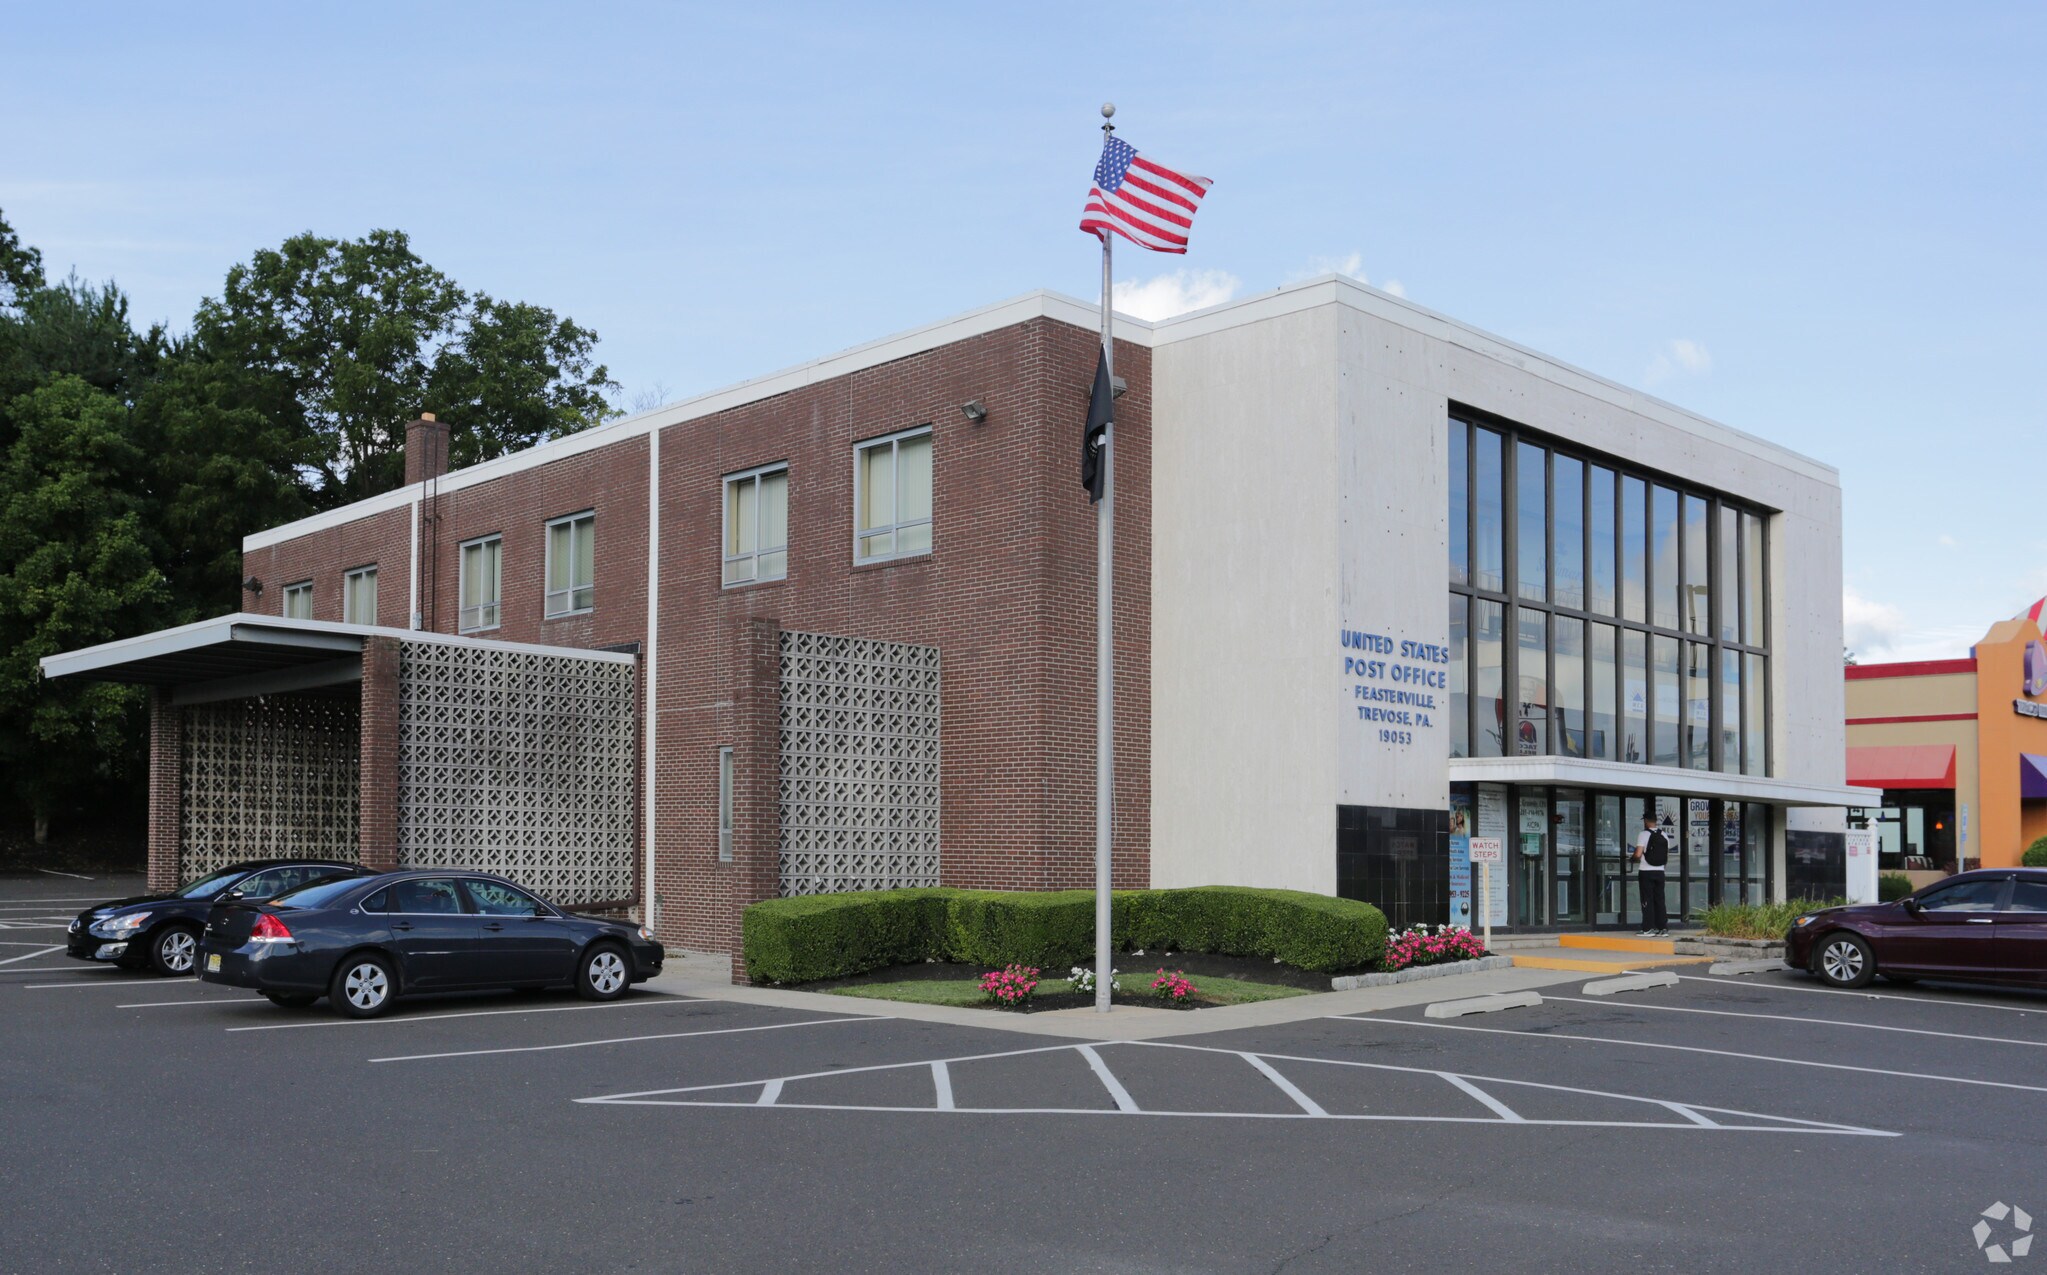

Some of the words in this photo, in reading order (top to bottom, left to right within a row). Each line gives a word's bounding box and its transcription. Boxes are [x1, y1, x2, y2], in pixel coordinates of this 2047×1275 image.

[1341, 629, 1394, 654] UNITED
[1401, 640, 1449, 664] STATES
[1345, 656, 1386, 679] POST
[1391, 664, 1446, 689] OFFICE
[1355, 685, 1436, 710] FEASTERVILLE,
[1358, 706, 1412, 726] TREVOSE,
[1416, 713, 1433, 727] PA.
[1379, 729, 1412, 745] 19053
